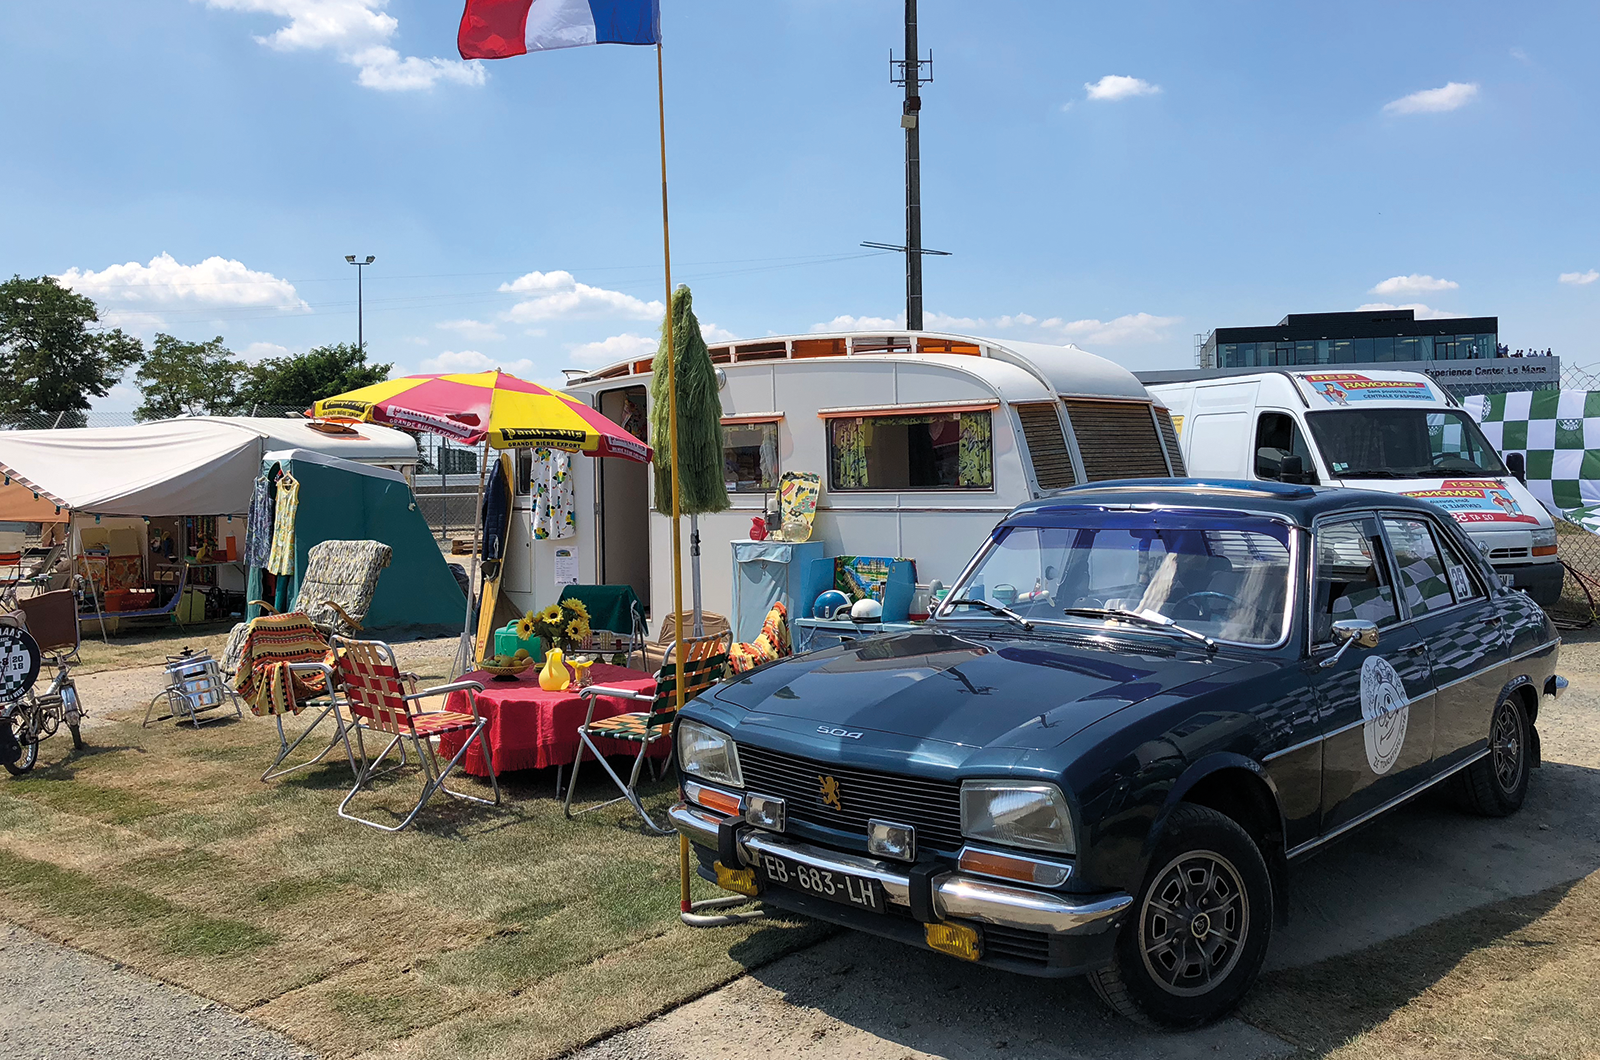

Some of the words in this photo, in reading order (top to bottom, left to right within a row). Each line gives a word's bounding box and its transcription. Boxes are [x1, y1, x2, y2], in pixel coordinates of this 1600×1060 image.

[1425, 368, 1472, 377] Experience
[1475, 367, 1504, 375] Center
[1508, 366, 1518, 374] Le
[1521, 365, 1546, 374] Mans
[1343, 381, 1418, 389] RAMONAGE
[389, 418, 416, 428] GRANDE
[12, 655, 24, 663] 20
[13, 662, 24, 670] 18
[816, 725, 864, 739] 504
[764, 855, 876, 908] EB-683-LH
